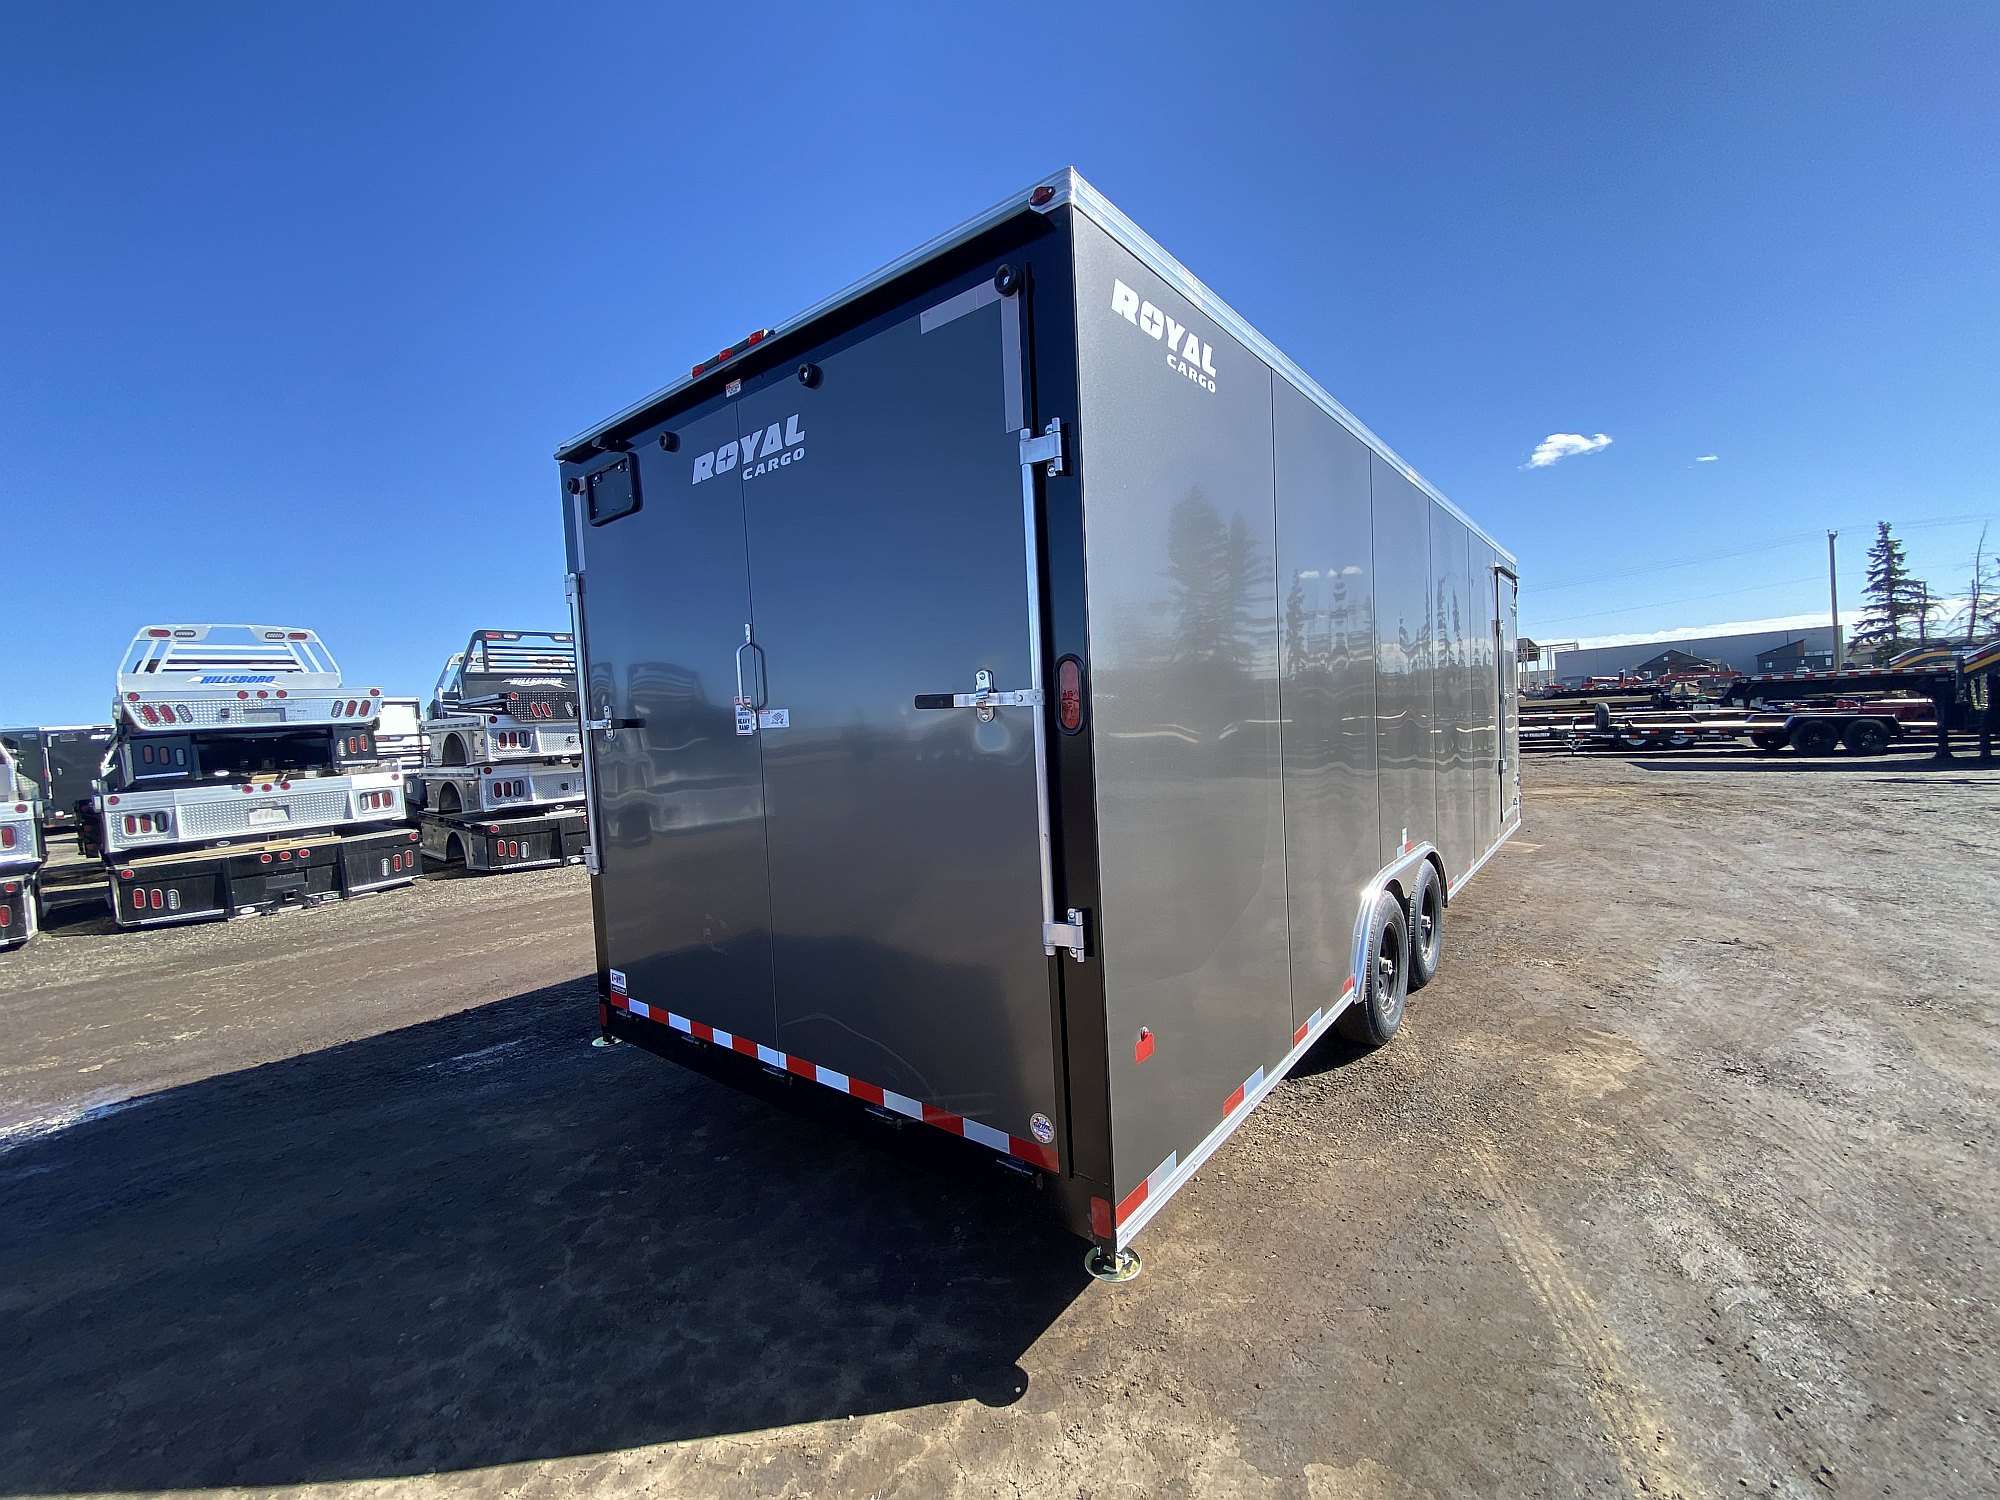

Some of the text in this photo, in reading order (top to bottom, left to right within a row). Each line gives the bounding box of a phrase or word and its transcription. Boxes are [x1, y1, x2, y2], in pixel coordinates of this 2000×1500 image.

[1111, 278, 1217, 378] ROYAL
[1166, 353, 1216, 393] CARGO
[692, 413, 806, 485] ROYAL
[742, 447, 805, 481] CARGO
[200, 675, 276, 684] HILLSBORO
